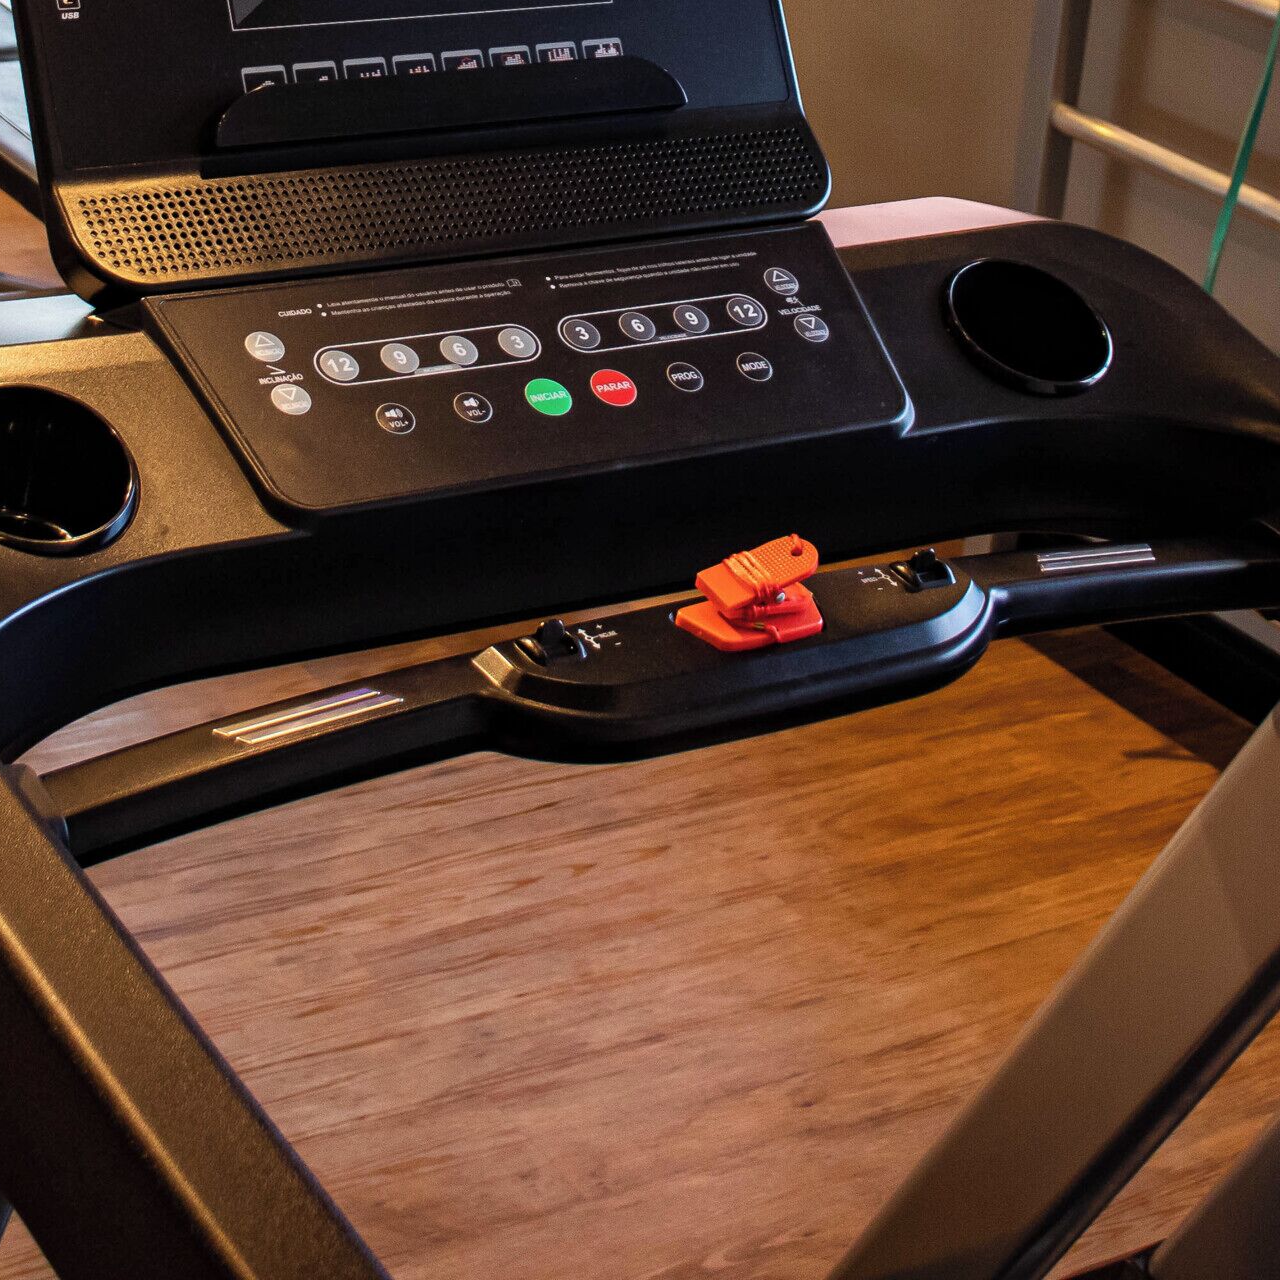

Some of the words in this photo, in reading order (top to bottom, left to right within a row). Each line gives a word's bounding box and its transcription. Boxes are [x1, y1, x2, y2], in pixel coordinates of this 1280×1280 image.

[61, 12, 80, 20] USB
[278, 308, 312, 318] CUIDADO
[777, 305, 821, 316] VELOCIDADE
[575, 327, 589, 340] 3
[631, 319, 644, 332] 6
[685, 312, 698, 325] 9
[733, 304, 758, 318] 12
[327, 358, 355, 373] 12
[394, 351, 407, 365] 9
[453, 343, 466, 356] 6
[511, 335, 524, 349] 3
[741, 361, 768, 371] MODE
[258, 373, 304, 385] INCLINAÇÃO
[671, 371, 701, 382] PROG.
[596, 381, 631, 393] PARAR
[530, 391, 567, 402] INICIAR
